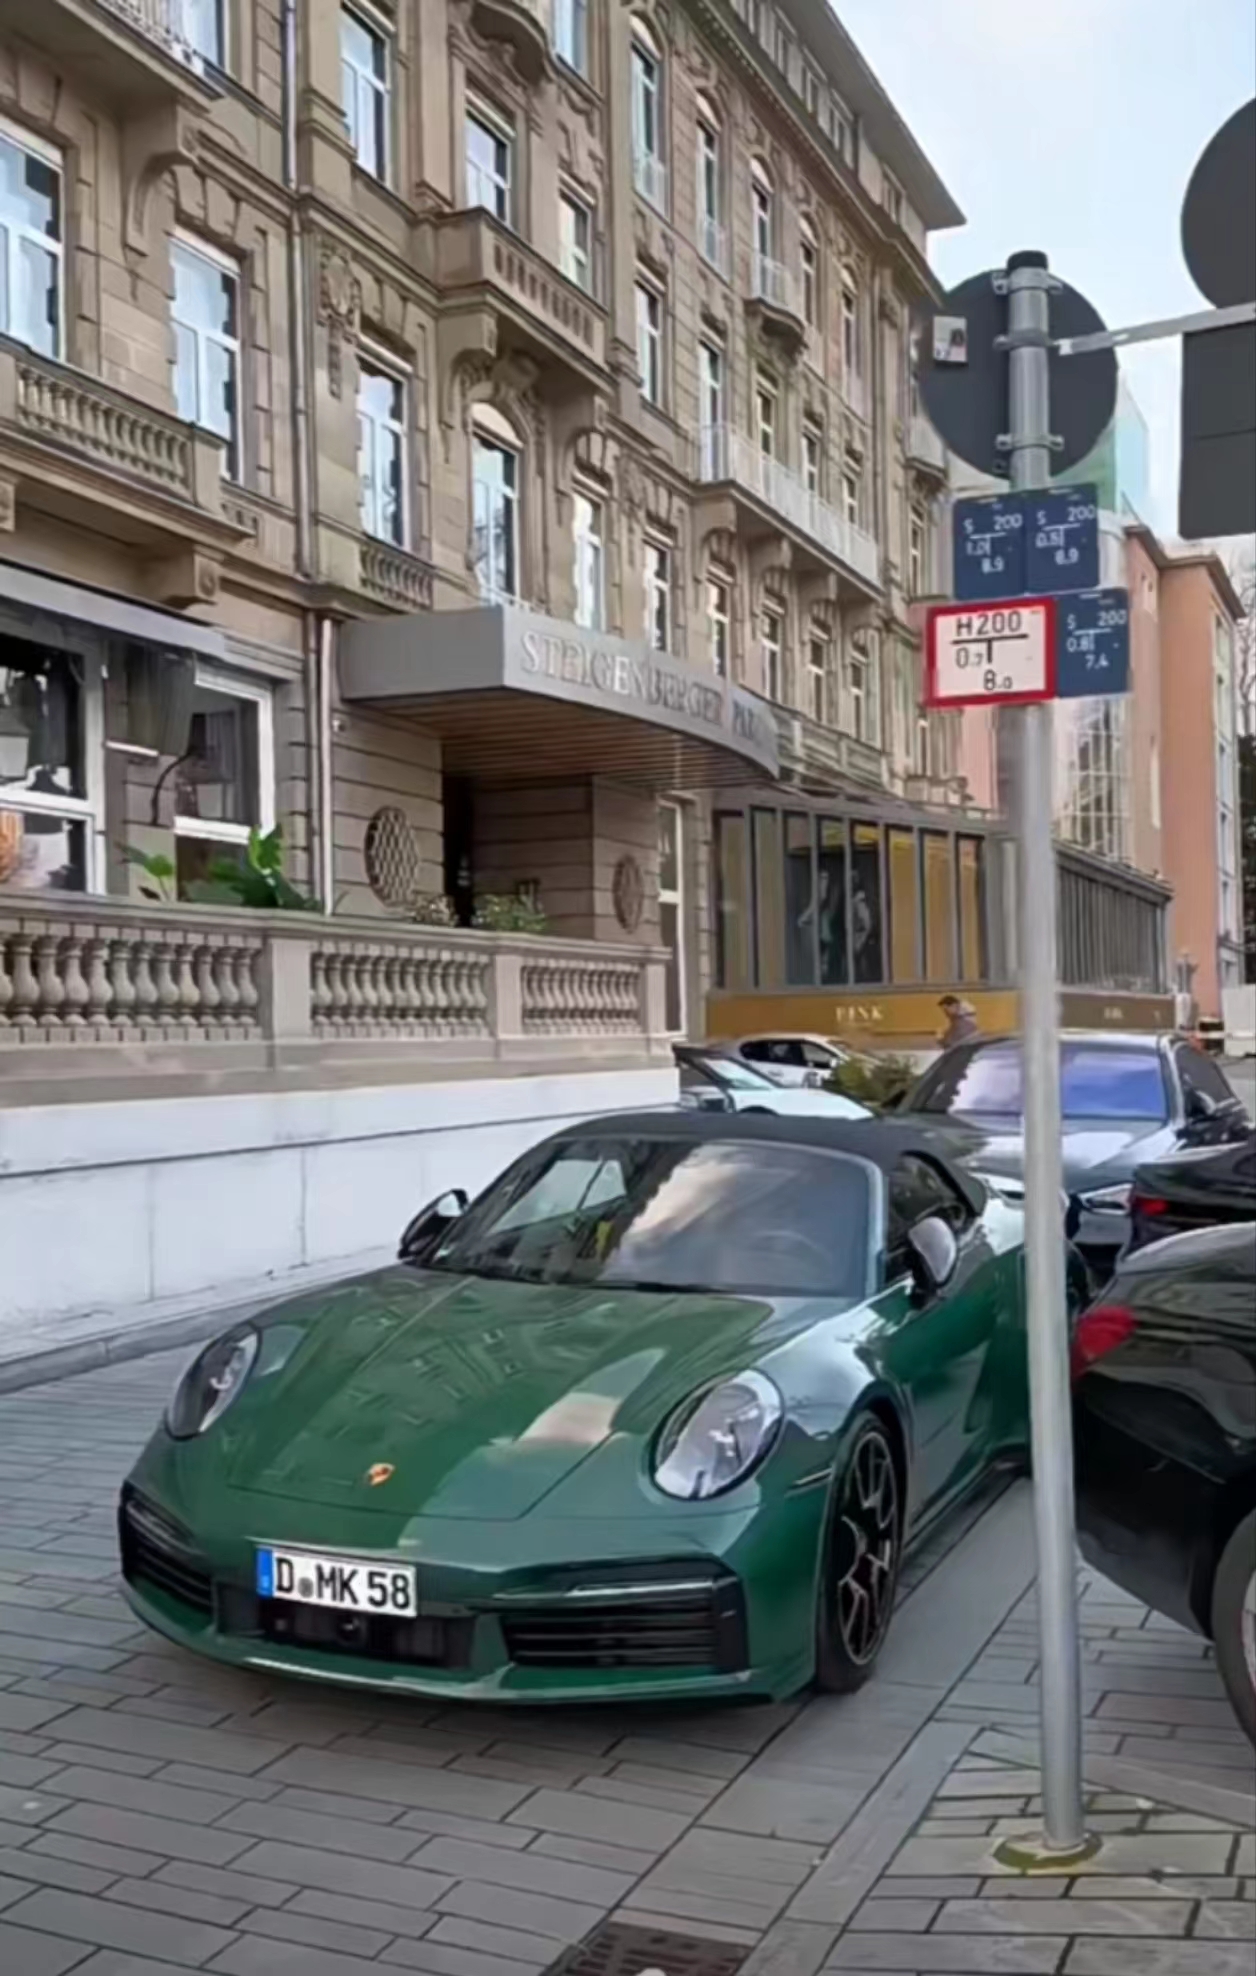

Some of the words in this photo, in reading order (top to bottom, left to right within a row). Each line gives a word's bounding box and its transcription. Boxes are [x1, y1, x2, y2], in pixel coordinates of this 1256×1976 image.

[993, 513, 1023, 531] 200
[1067, 505, 1096, 522] 200
[1097, 610, 1127, 628] 200
[983, 669, 1013, 691] 8.0
[276, 1556, 295, 1594] D
[315, 1563, 359, 1605] MK
[367, 1570, 410, 1610] 58
